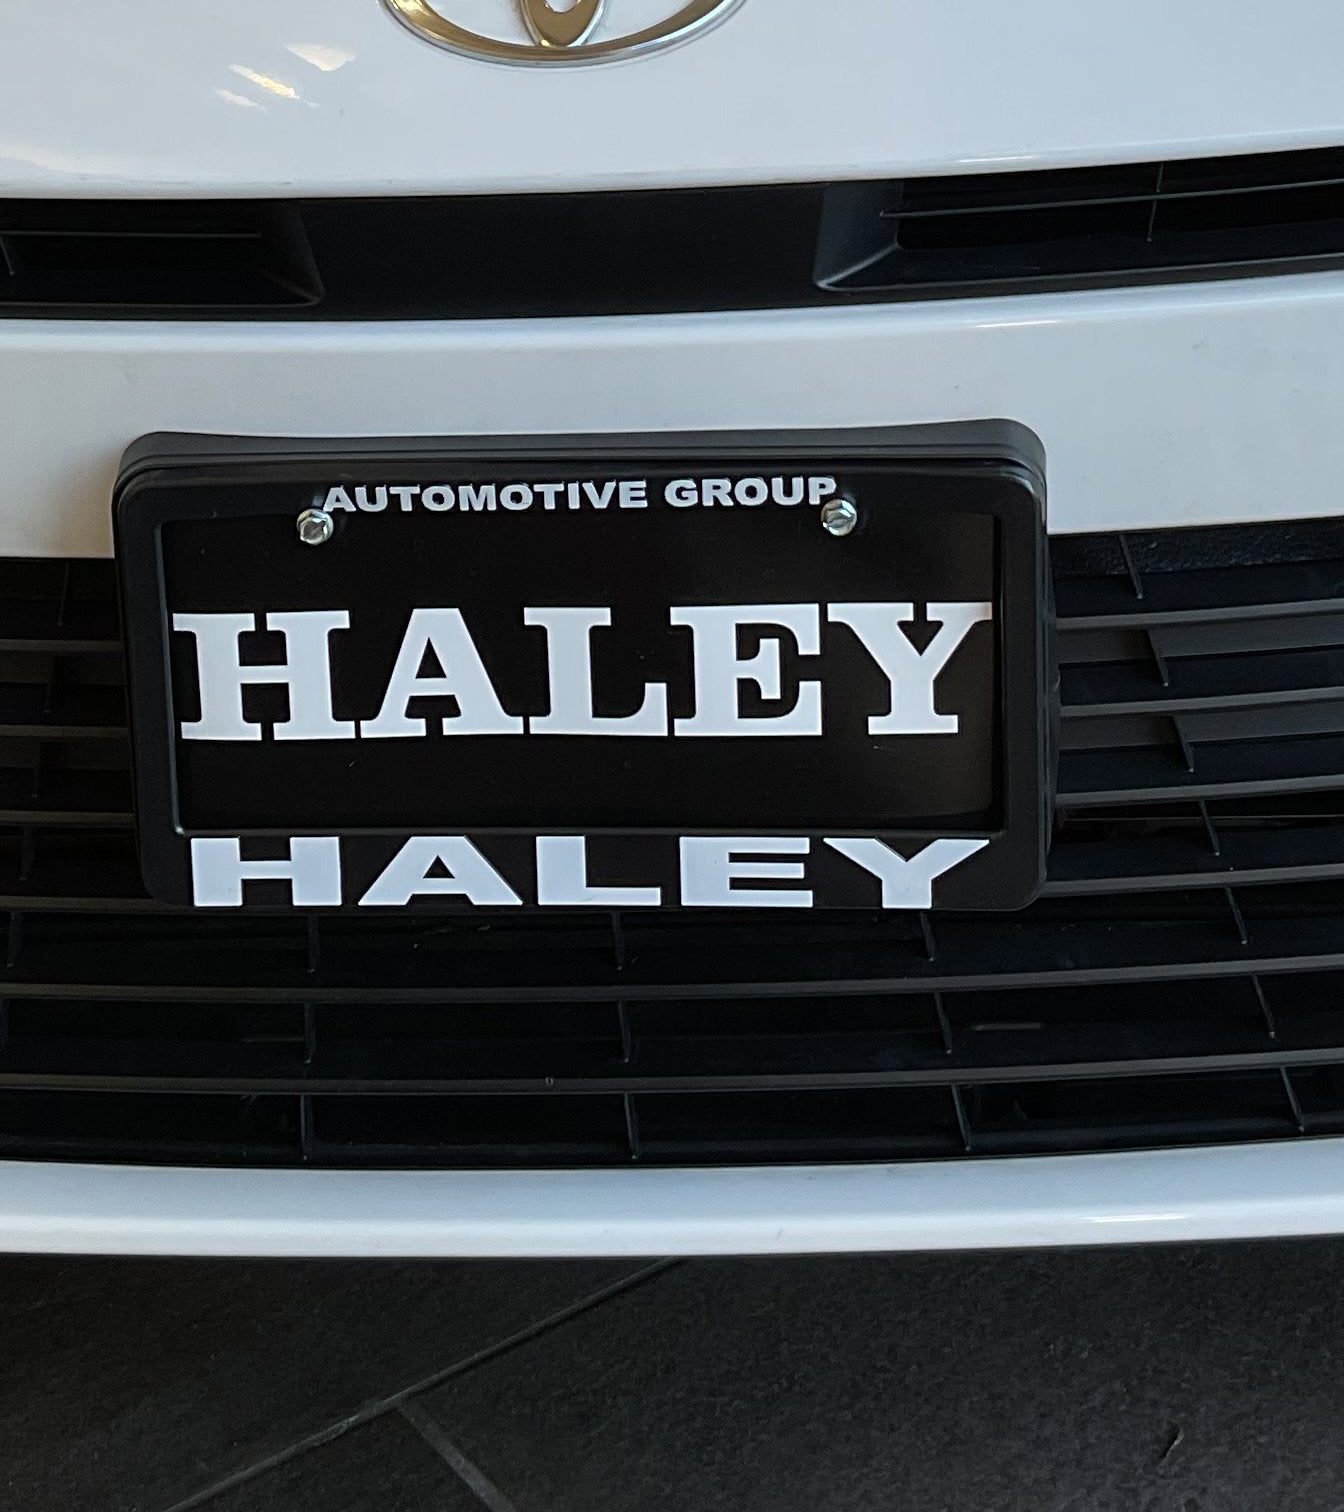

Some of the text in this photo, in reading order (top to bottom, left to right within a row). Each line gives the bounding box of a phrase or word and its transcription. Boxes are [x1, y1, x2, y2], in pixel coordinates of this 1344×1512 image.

[323, 476, 838, 513] AUTOMOTIVE GROUP
[172, 602, 993, 741] HALEY
[190, 835, 991, 909] HALEY
